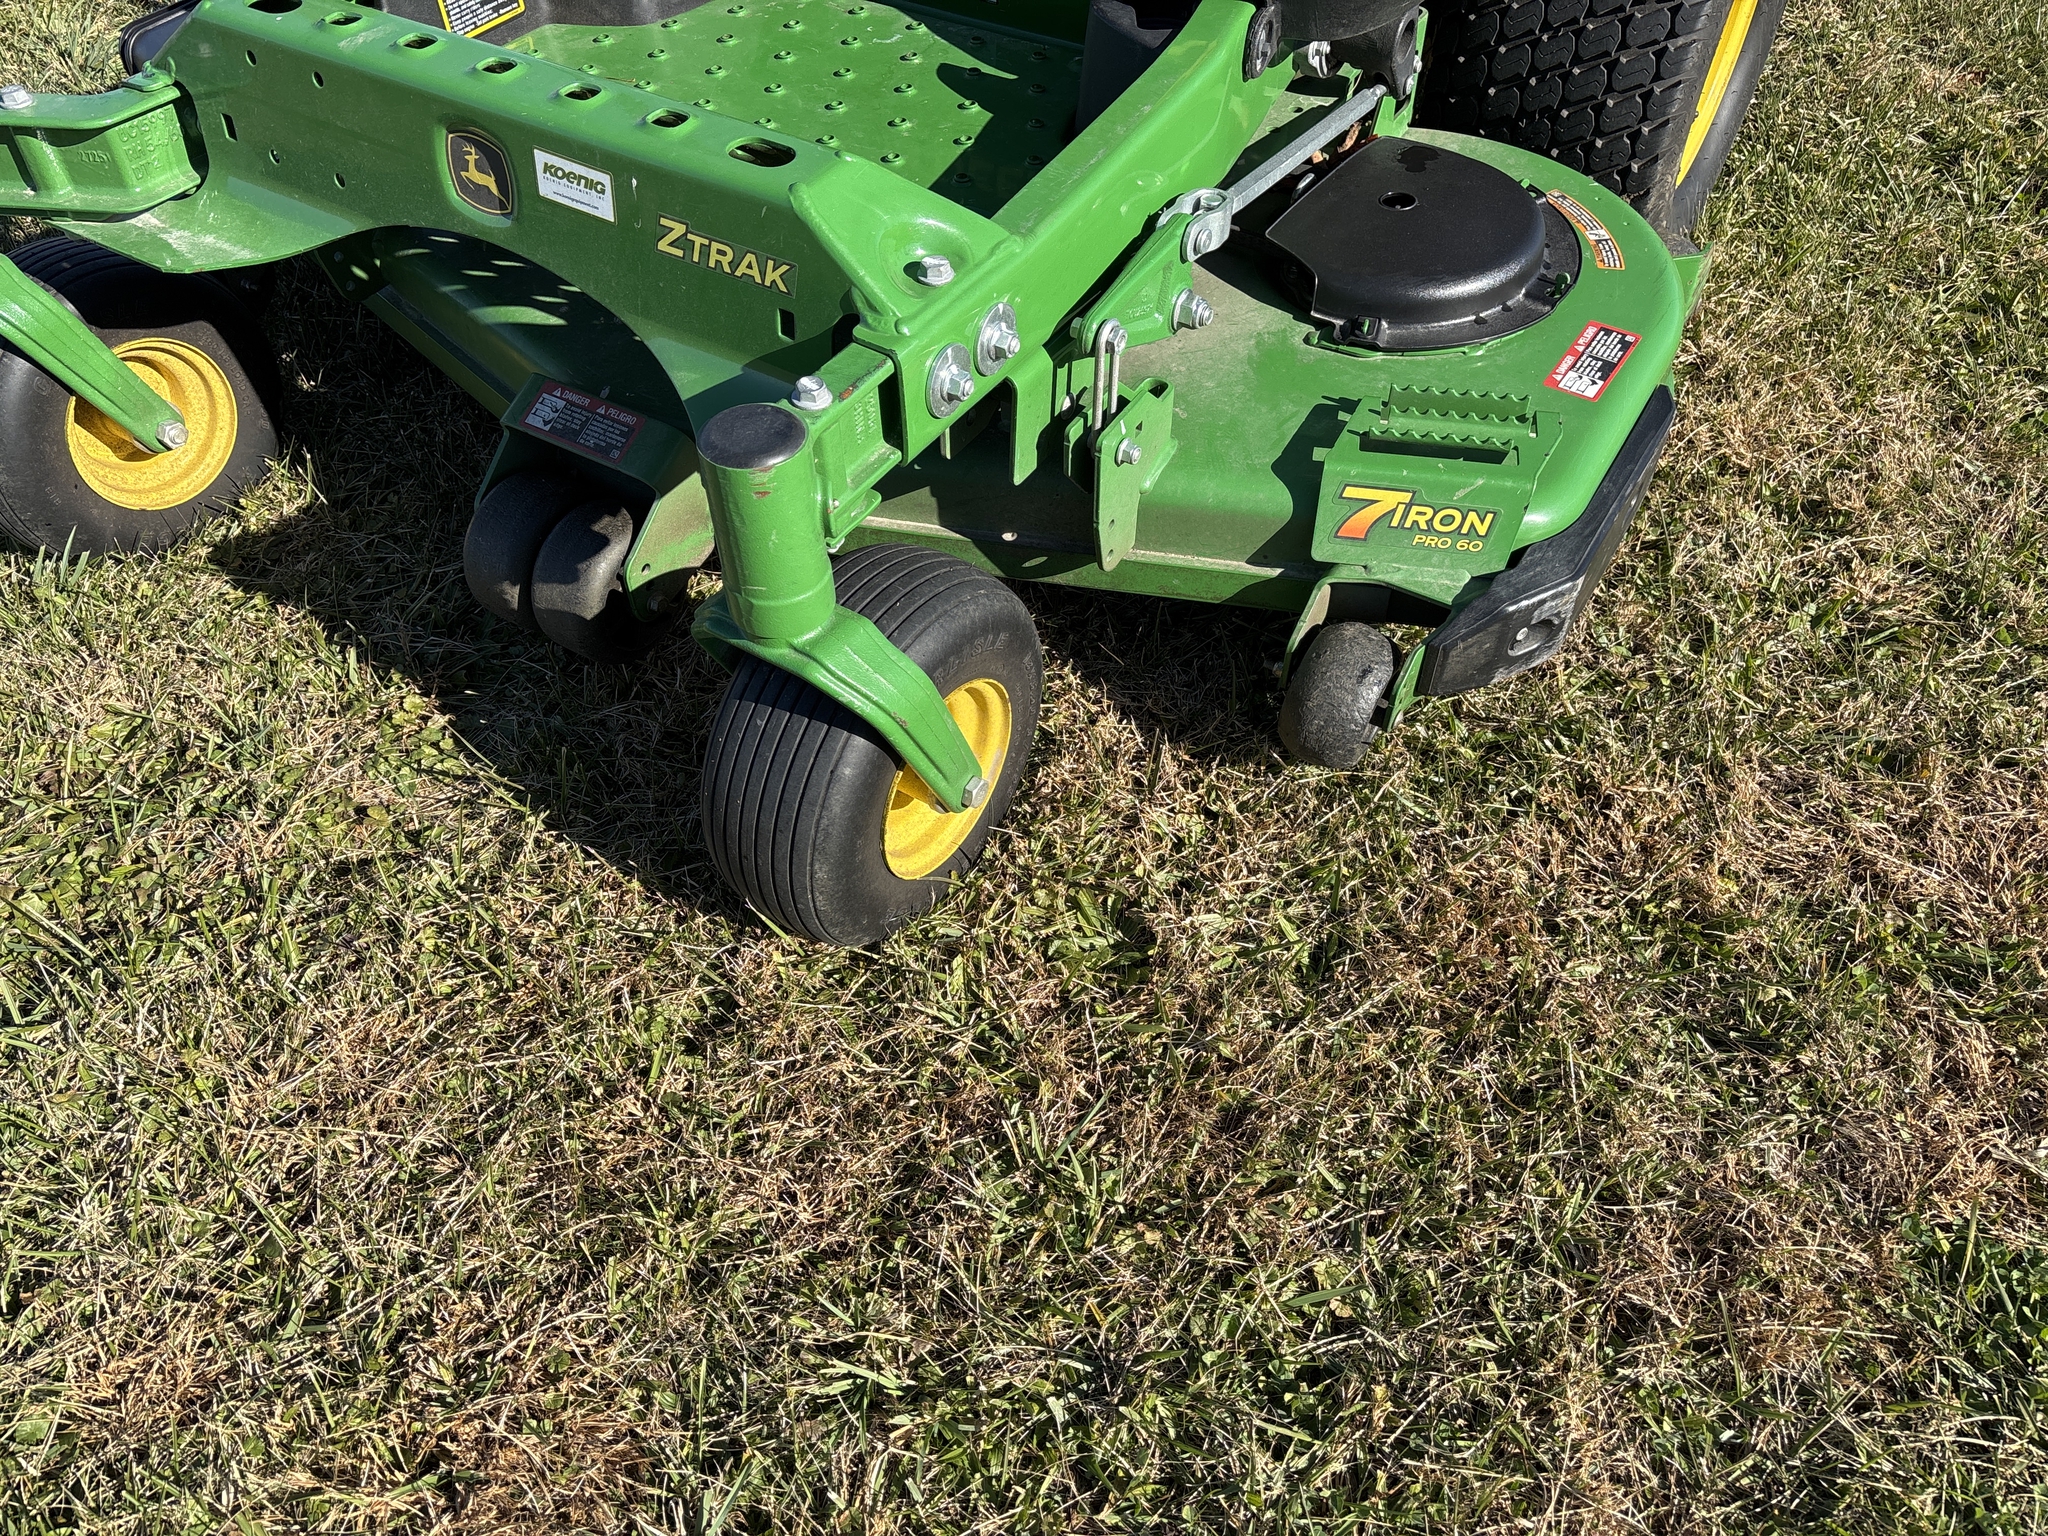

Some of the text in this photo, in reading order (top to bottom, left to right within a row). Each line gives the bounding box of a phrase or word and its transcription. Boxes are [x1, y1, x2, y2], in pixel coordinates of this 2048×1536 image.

[657, 216, 791, 294] ZTRAK
[1577, 325, 1598, 346] PELIGRO
[1555, 354, 1576, 374] DANGER
[562, 389, 591, 407] DANGER
[605, 407, 637, 425] PELIGRO
[1411, 534, 1484, 552] PRO 60
[932, 631, 1009, 686] RLISLE
